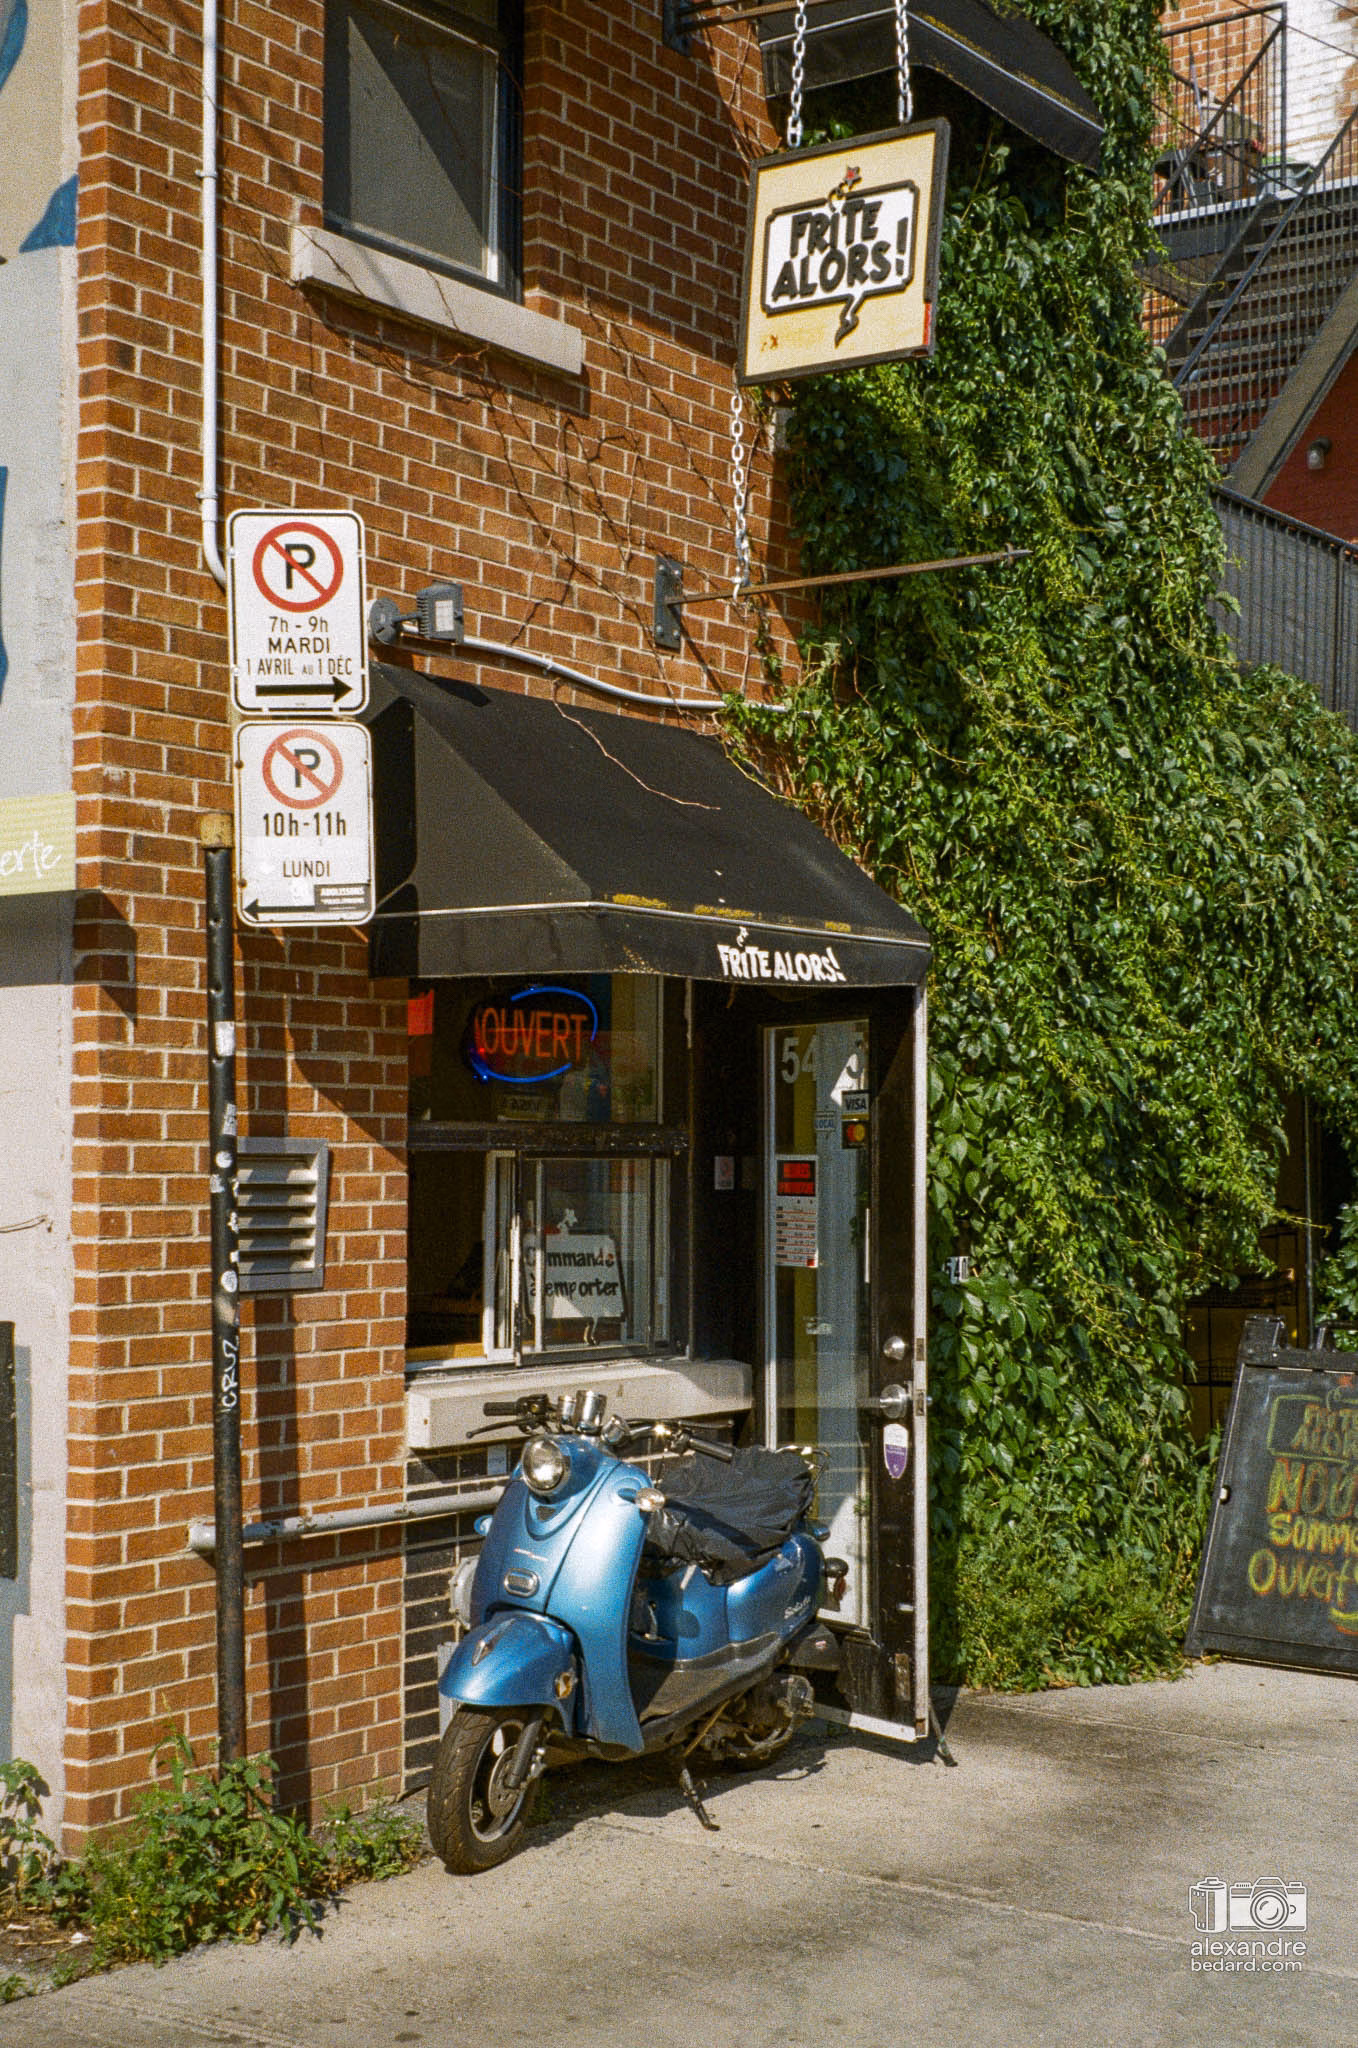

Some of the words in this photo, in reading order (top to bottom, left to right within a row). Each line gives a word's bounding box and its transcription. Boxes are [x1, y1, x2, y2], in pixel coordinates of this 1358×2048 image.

[772, 217, 909, 302] ALORS!
[269, 616, 289, 633] 7h
[308, 616, 329, 633] 9h
[268, 637, 330, 654] MARDI
[247, 659, 251, 675] 1
[257, 659, 294, 675] AVRIL
[302, 665, 313, 675] AU
[318, 659, 323, 675] 1
[328, 655, 352, 675] DÉC
[263, 812, 347, 836] 10h-11h
[283, 861, 330, 878] LUNDI
[774, 946, 846, 982] ALORS!
[481, 1008, 588, 1061] OUVERT
[845, 1098, 867, 1111] VISA
[527, 1246, 615, 1268] Cmmande
